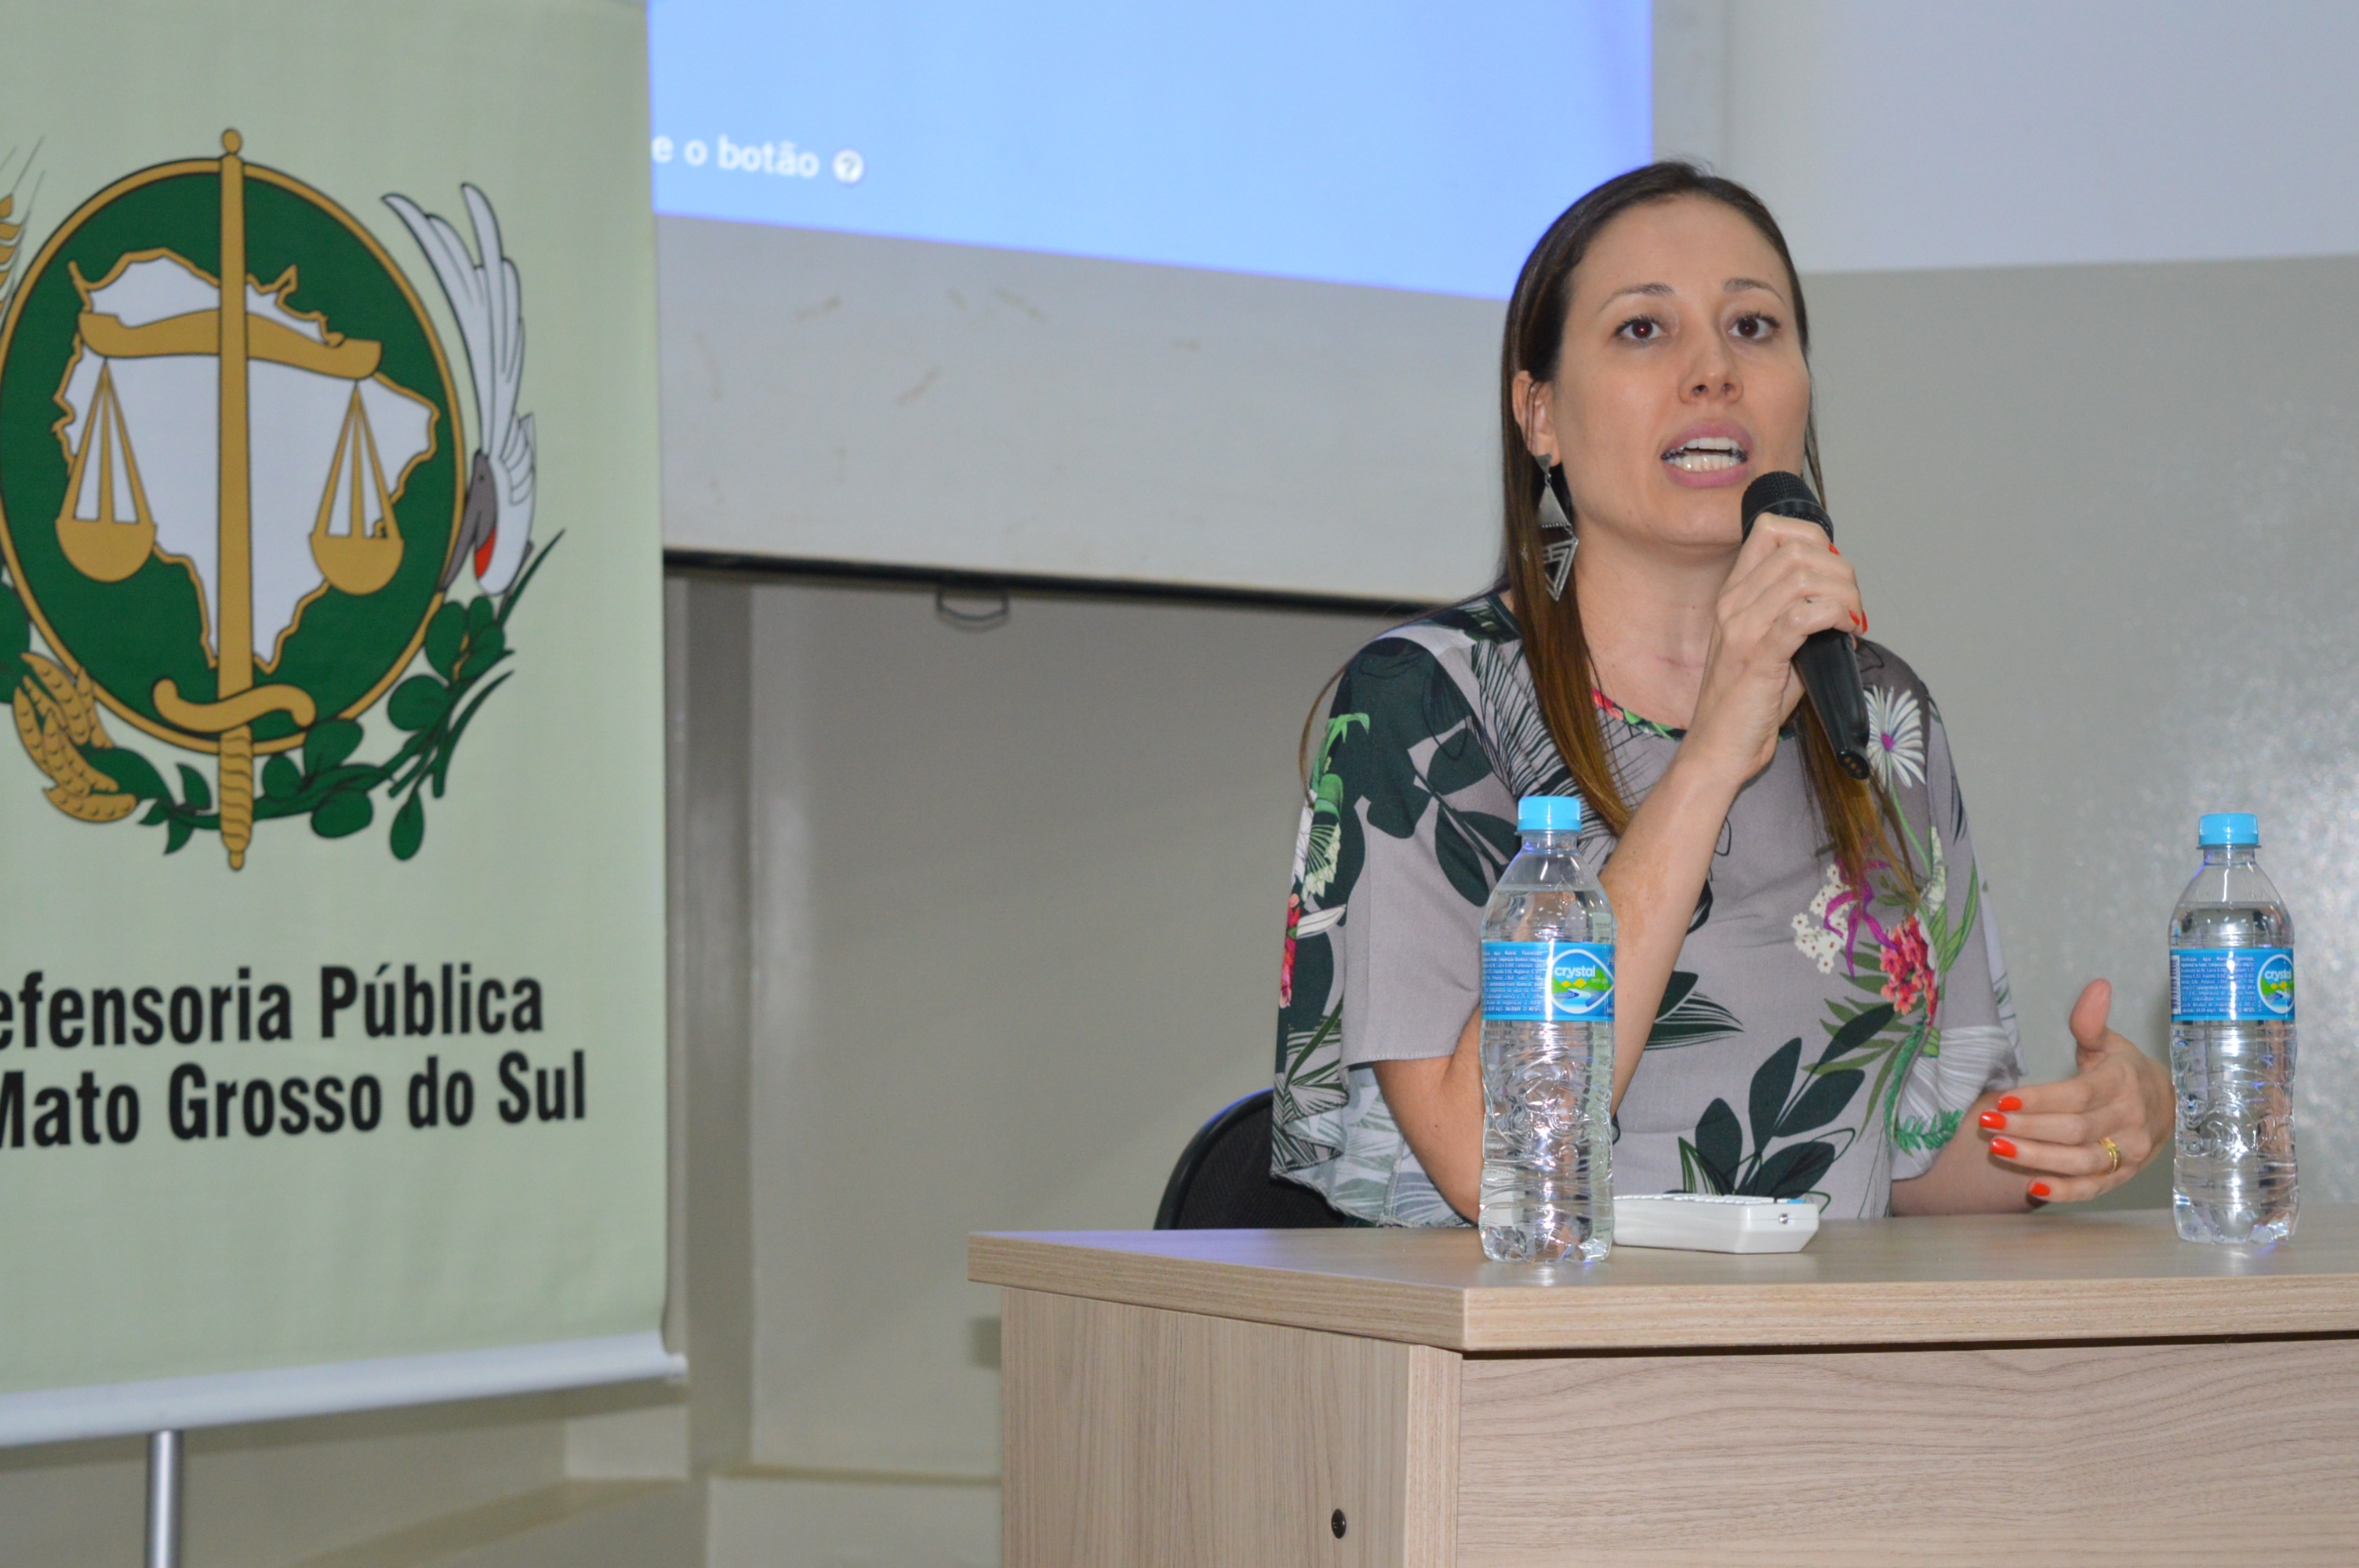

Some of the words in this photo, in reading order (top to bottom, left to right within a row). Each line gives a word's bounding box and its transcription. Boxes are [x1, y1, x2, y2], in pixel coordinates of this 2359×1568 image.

[684, 140, 707, 165] o
[718, 134, 820, 178] botão
[321, 963, 543, 1039] Pública
[1554, 965, 1596, 978] crystal
[168, 1062, 382, 1141] Grosso
[408, 1055, 474, 1129] do
[498, 1050, 585, 1124] Sul
